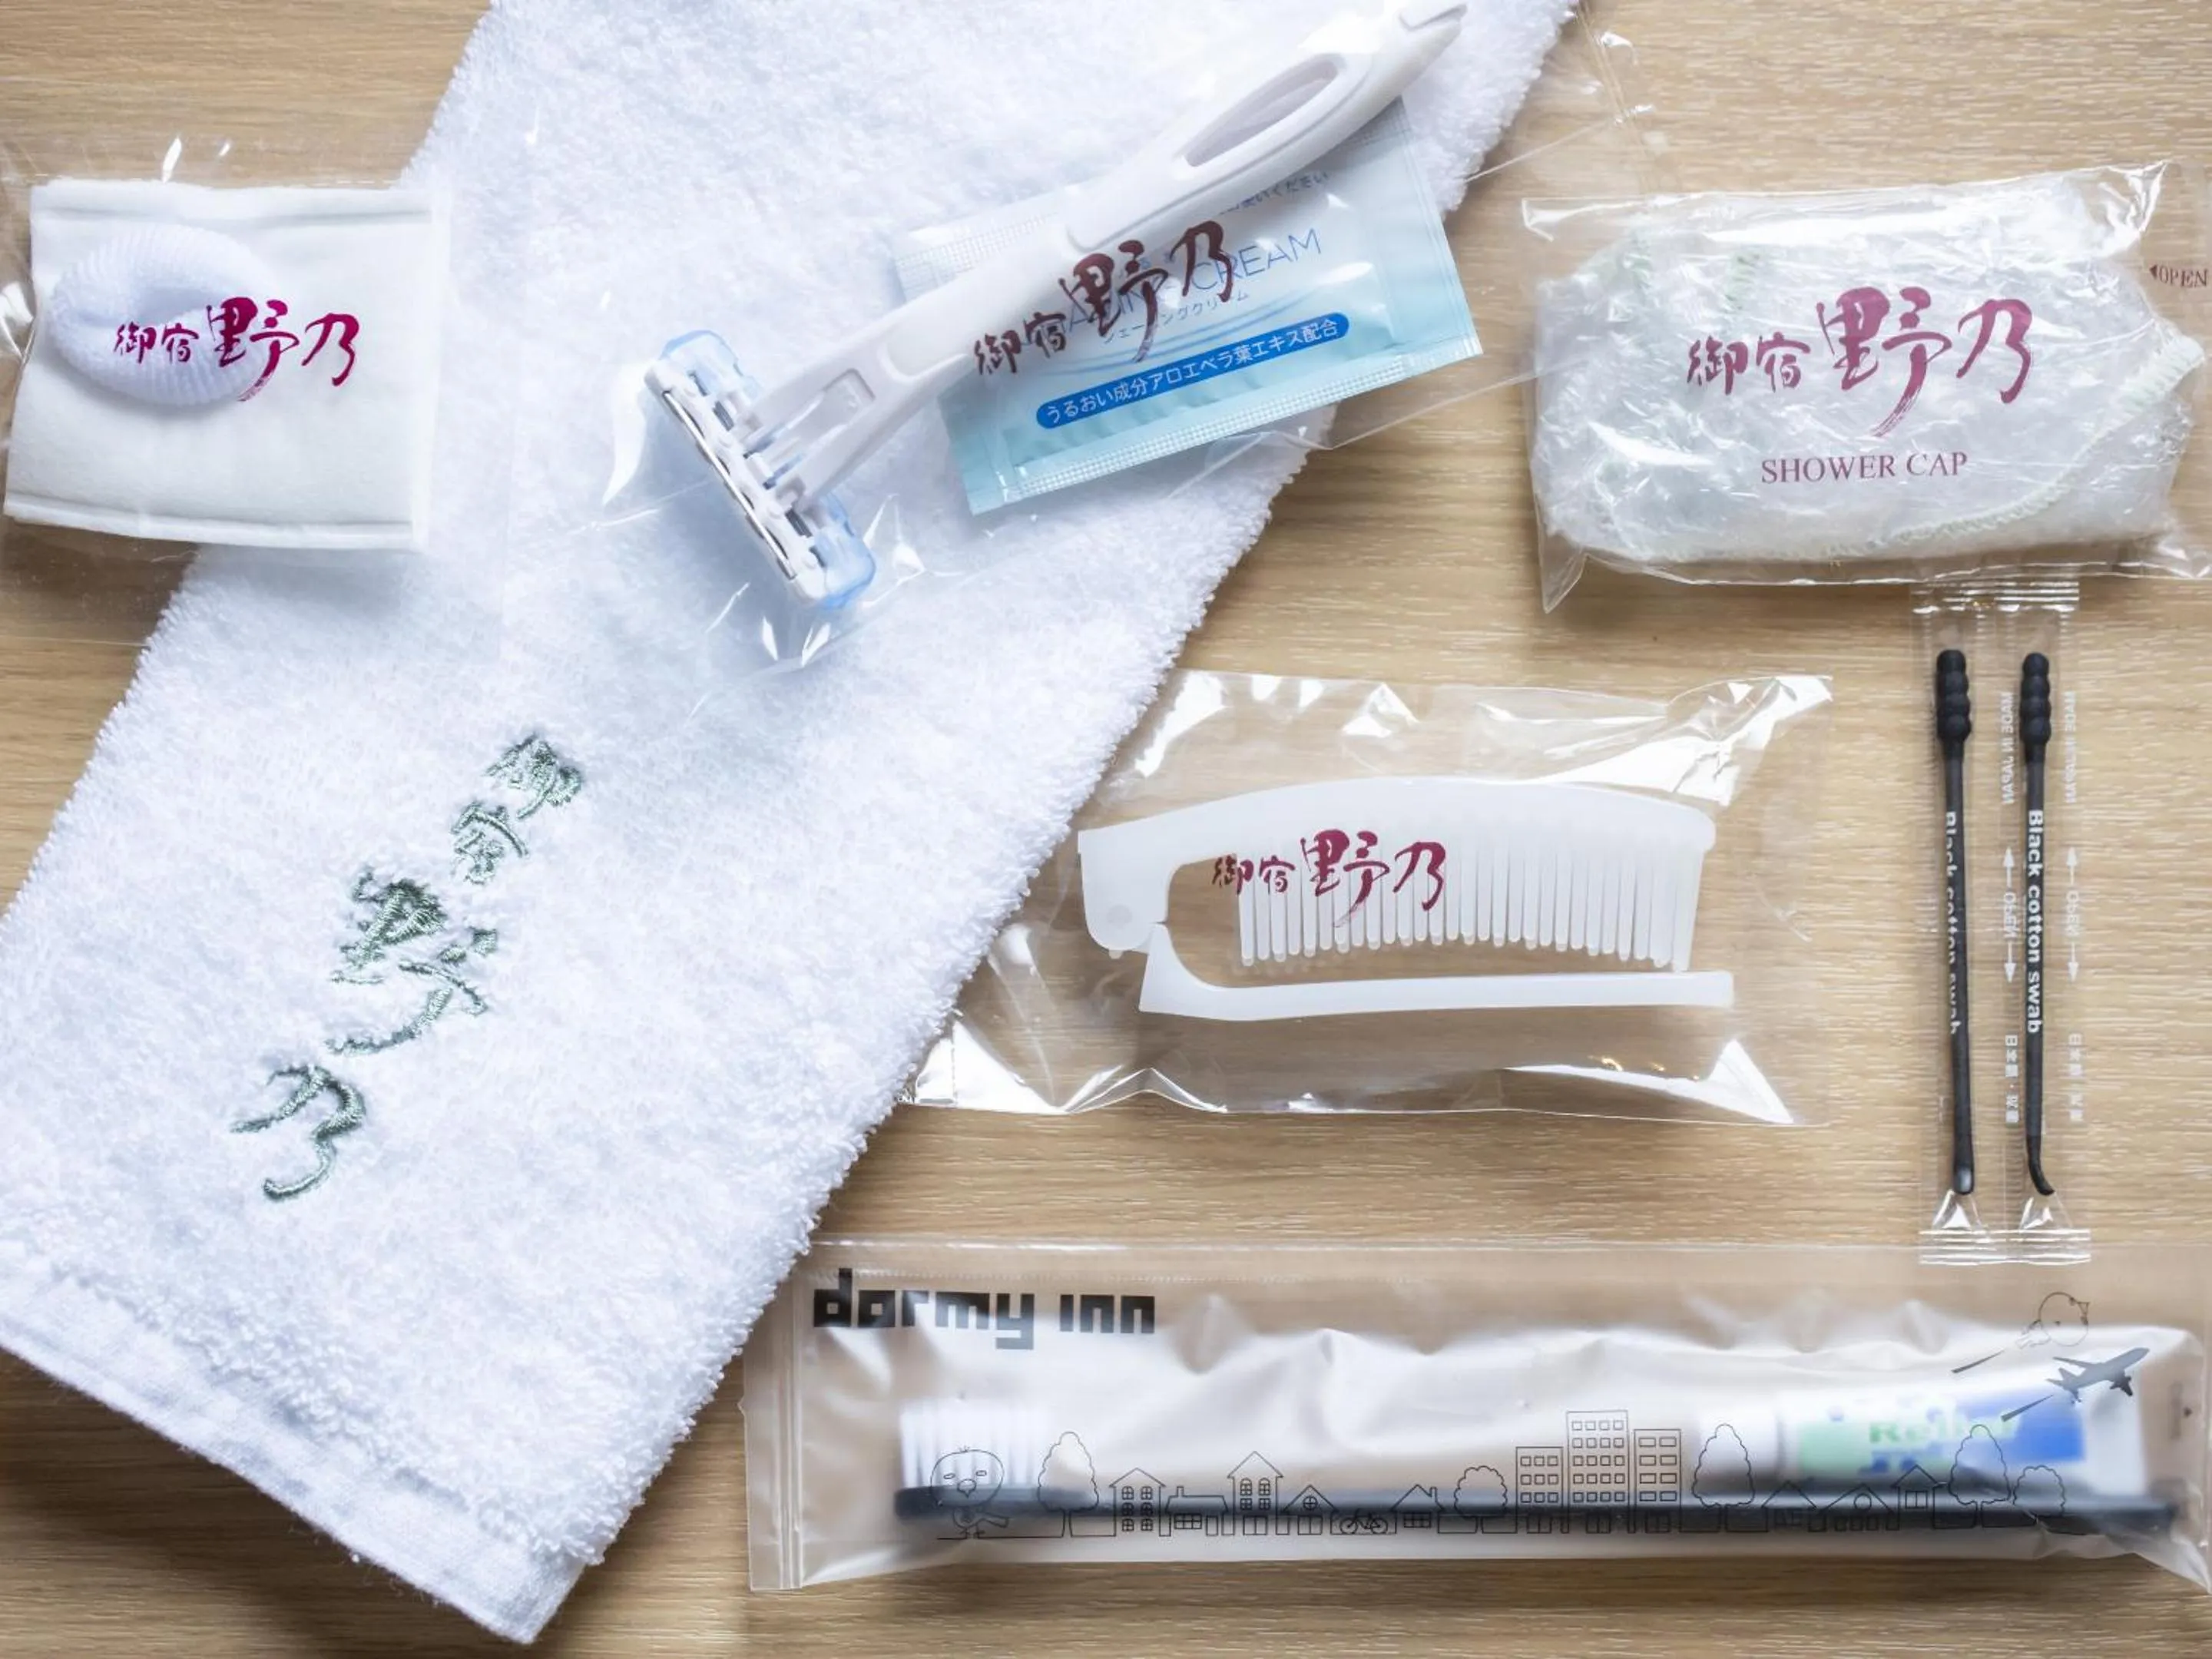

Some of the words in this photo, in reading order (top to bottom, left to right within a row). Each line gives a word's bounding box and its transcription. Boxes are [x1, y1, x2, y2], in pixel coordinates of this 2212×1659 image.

[1190, 227, 1322, 290] CREAM
[113, 296, 361, 402] 御宿野乃
[1046, 320, 1339, 424] うるおい成分アロエベラ葉エキス配合
[1686, 287, 2033, 438] 御宿野乃
[1761, 454, 1896, 483] SHOWER
[1906, 451, 1968, 476] CAP
[1212, 829, 1446, 929] 御宿野乃
[2028, 810, 2044, 877] Black
[2027, 884, 2043, 963] cotton
[2027, 971, 2042, 1034] swab
[813, 1267, 1035, 1350] dormy
[1060, 1293, 1155, 1334] inn
